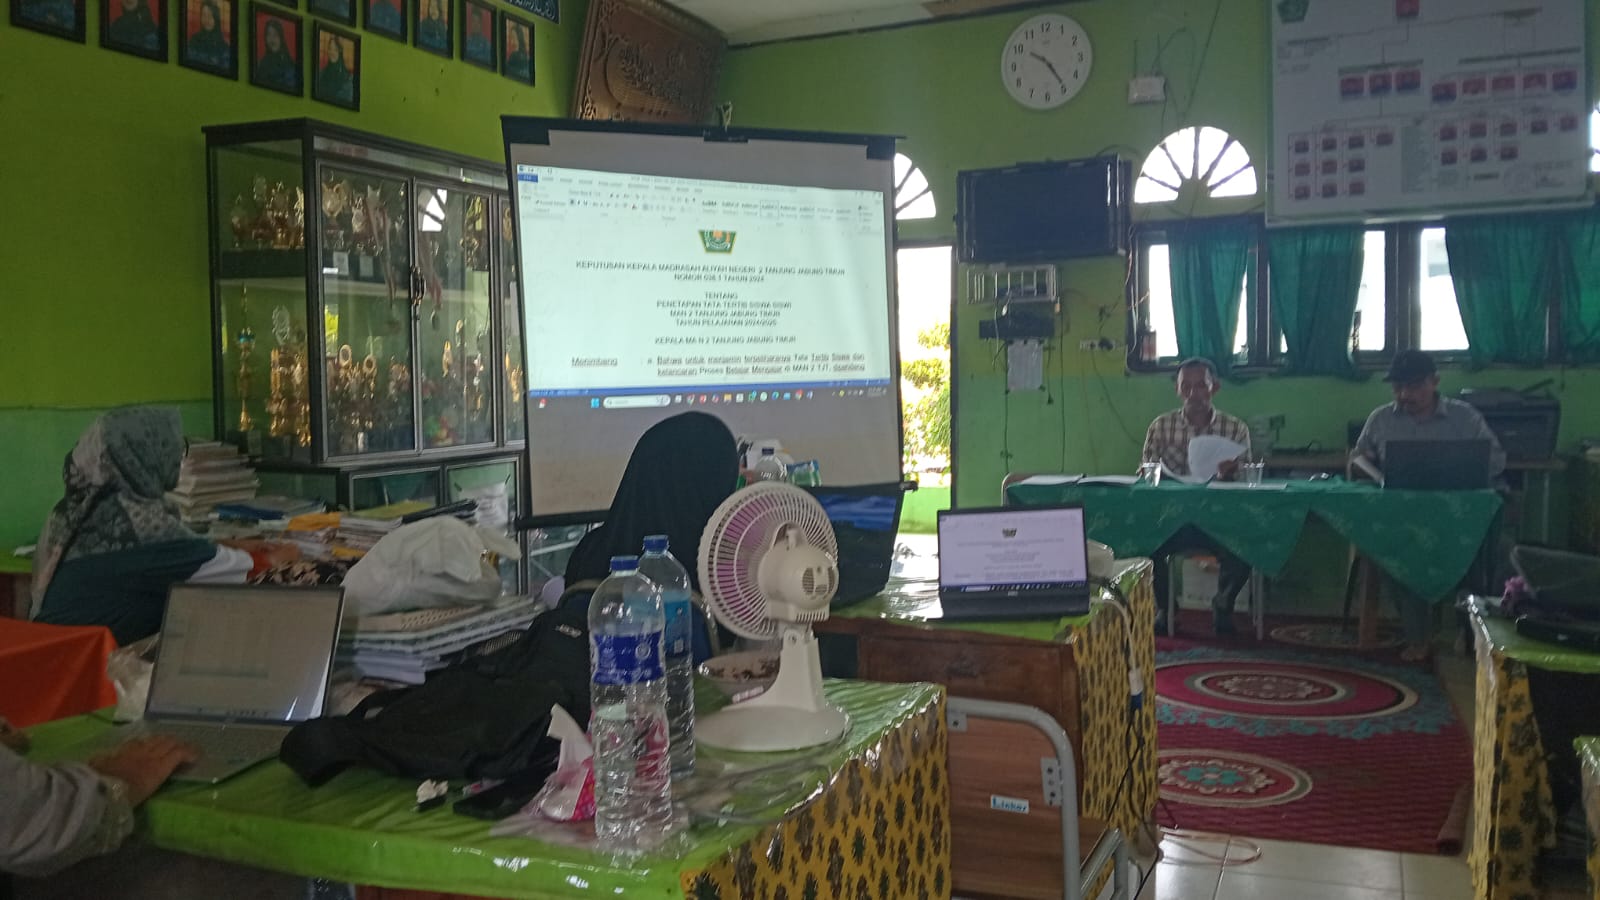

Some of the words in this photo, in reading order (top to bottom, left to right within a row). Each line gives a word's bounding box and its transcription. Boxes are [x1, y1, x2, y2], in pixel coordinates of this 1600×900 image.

[1041, 22, 1051, 32] 12
[1060, 23, 1064, 36] 1
[1025, 29, 1034, 40] 11
[1072, 35, 1078, 47] 2
[1013, 43, 1024, 54] 10
[1078, 51, 1084, 62] 3
[1073, 69, 1079, 80] 4
[1030, 88, 1035, 99] 7
[576, 260, 625, 270] KEPUTUSAN
[626, 262, 656, 271] KEPALA
[729, 265, 756, 273] NEGERI
[765, 266, 796, 275] TANJUNG
[798, 267, 824, 276] JABUNG
[825, 267, 846, 276] TIMUR
[674, 273, 701, 281] NOMOR
[724, 274, 748, 282] TAHUN
[705, 291, 738, 300] TENTANG
[656, 300, 702, 309] PENETAPAN
[704, 300, 722, 308] TATA
[670, 309, 687, 318] MAN
[695, 309, 729, 318] TANJUNG
[730, 309, 758, 318] JABUNG
[760, 309, 781, 317] TIMUR
[676, 318, 701, 327] TAHUN
[702, 318, 744, 327] PELAJARAN
[655, 336, 685, 345] KEPALA
[712, 335, 745, 345] TANJUNG
[746, 335, 774, 344] JABUNG
[775, 335, 797, 343] TIMUR
[793, 363, 809, 371] MAN
